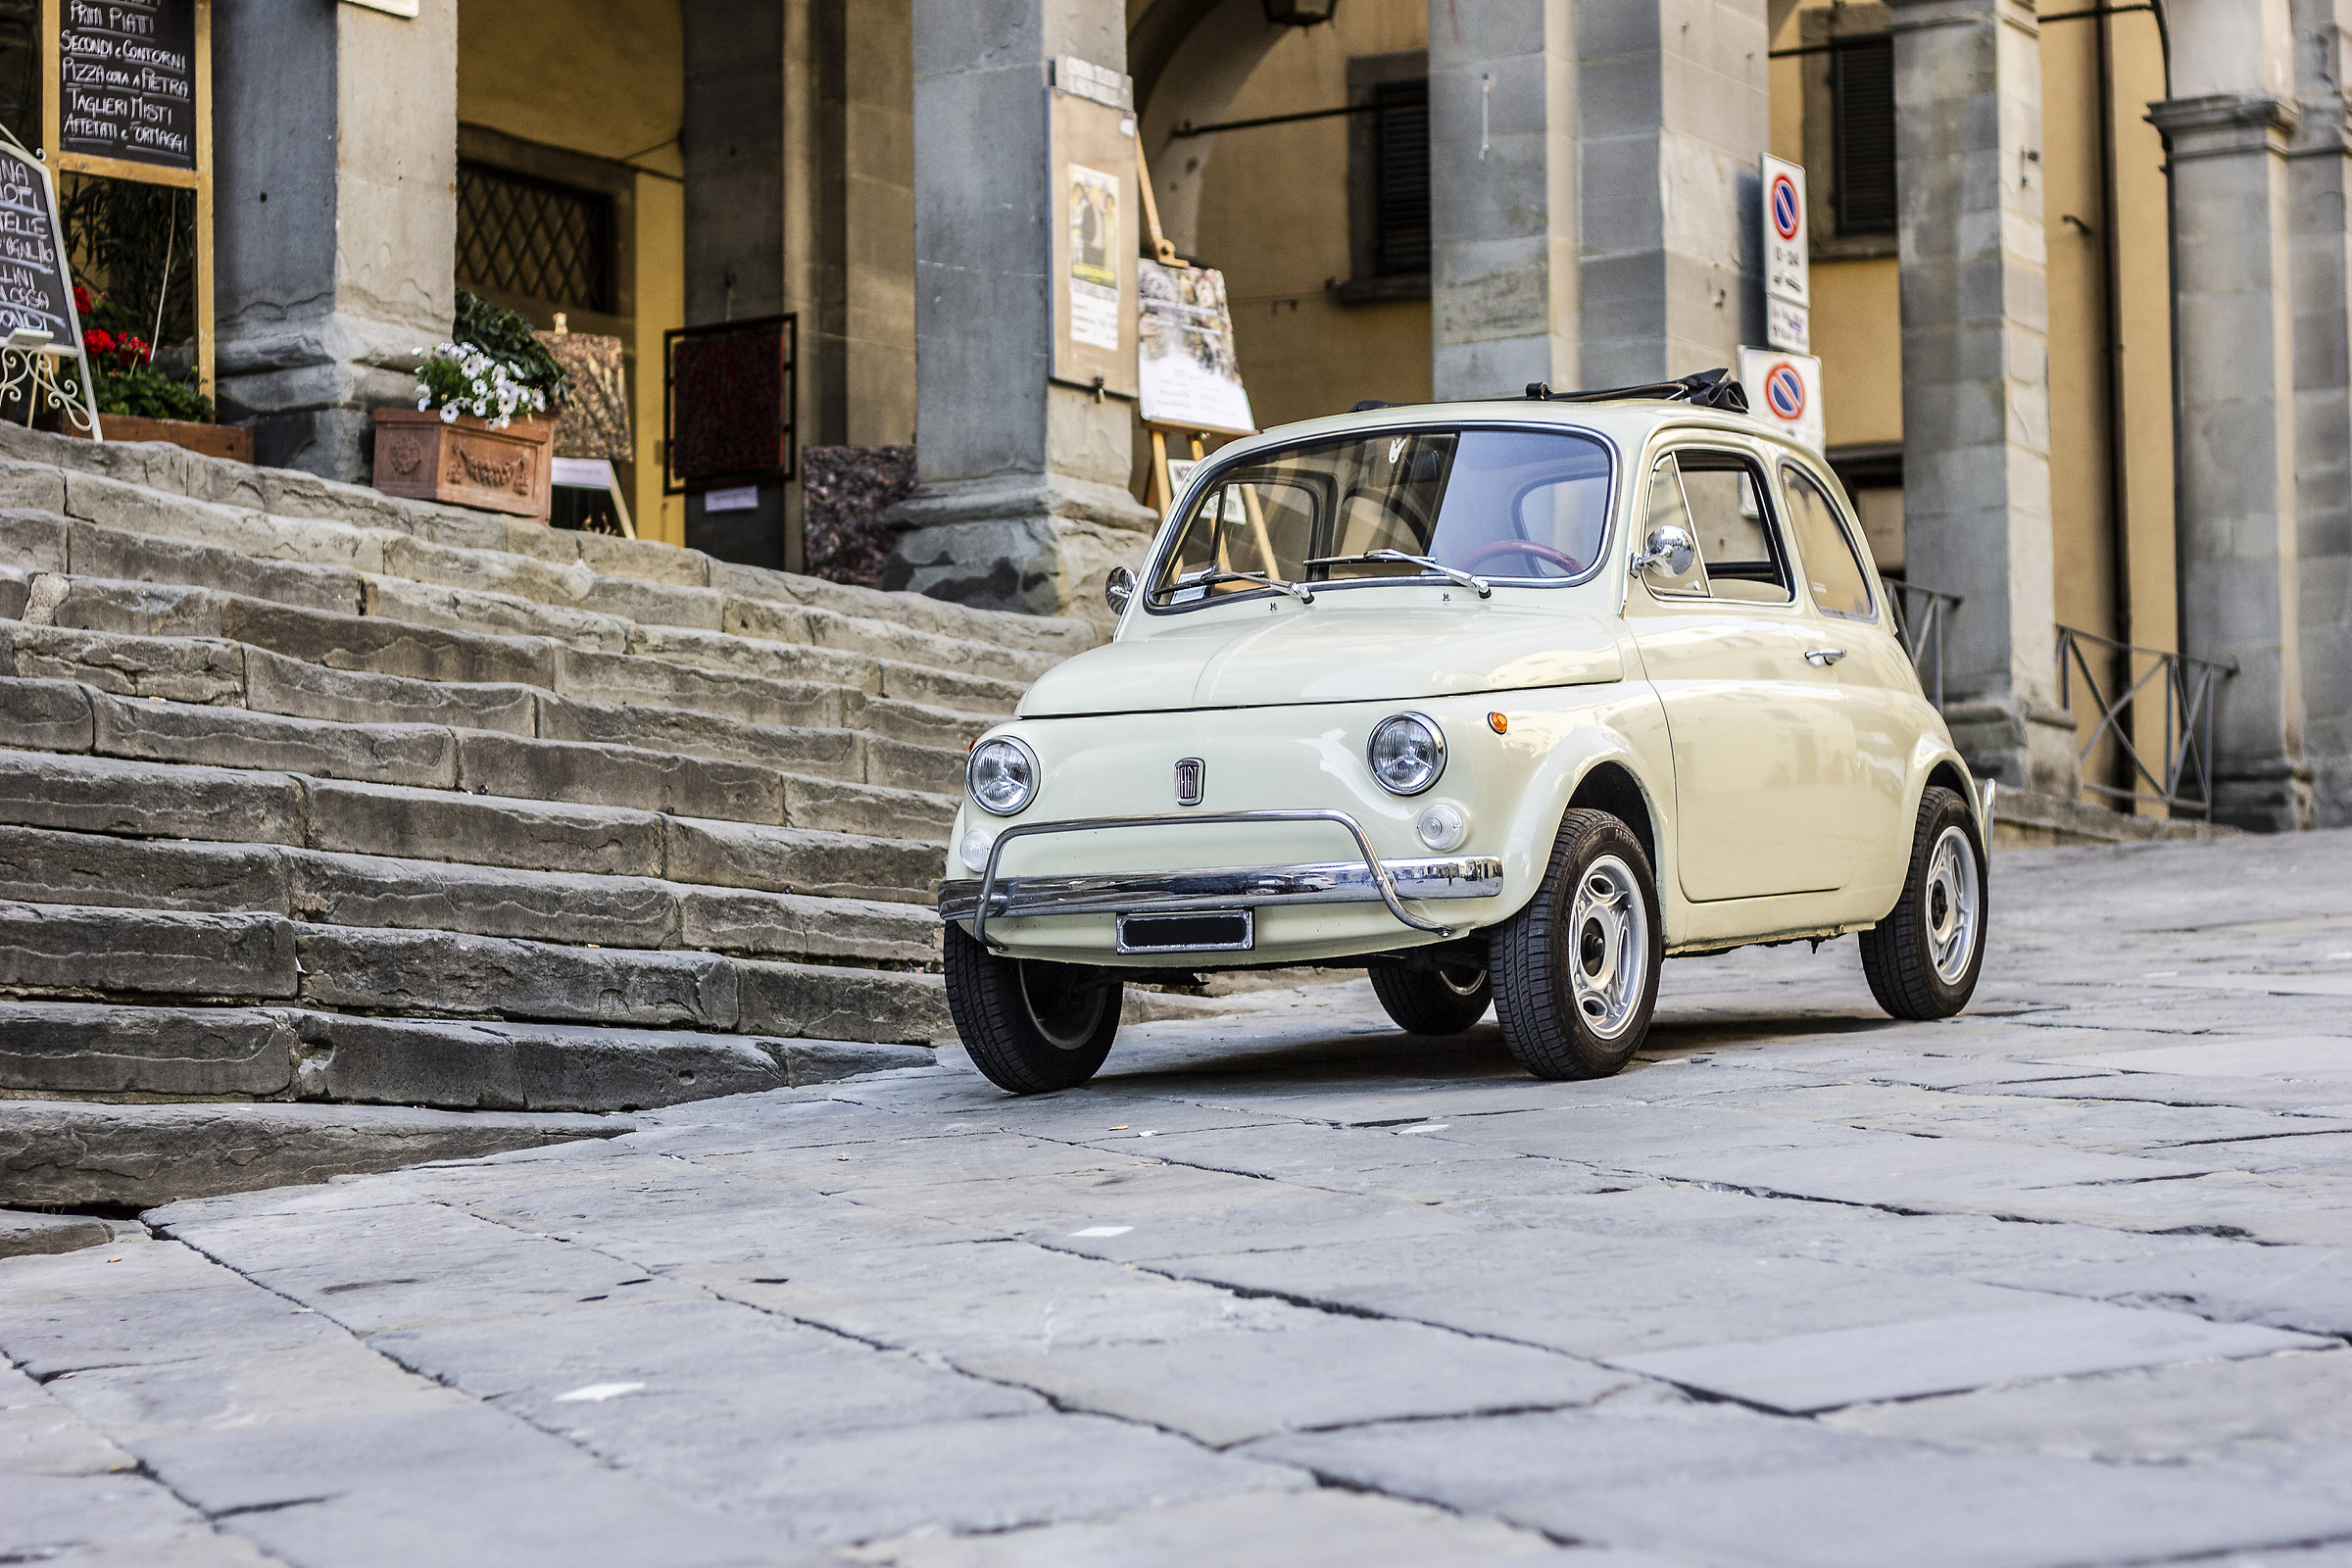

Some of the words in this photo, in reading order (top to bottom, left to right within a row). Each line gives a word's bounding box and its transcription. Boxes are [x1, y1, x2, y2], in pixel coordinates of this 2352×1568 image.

[109, 7, 154, 34] PIATTI
[60, 29, 113, 57] SECONDI
[122, 39, 186, 71] CONTORNI
[62, 56, 105, 82] PIZZA
[141, 67, 189, 98] PIETRA
[66, 87, 127, 119] TAGLIERI
[130, 96, 172, 126] MISTI
[128, 121, 188, 153] FORMAGGI
[1180, 765, 1199, 798] FIAT
